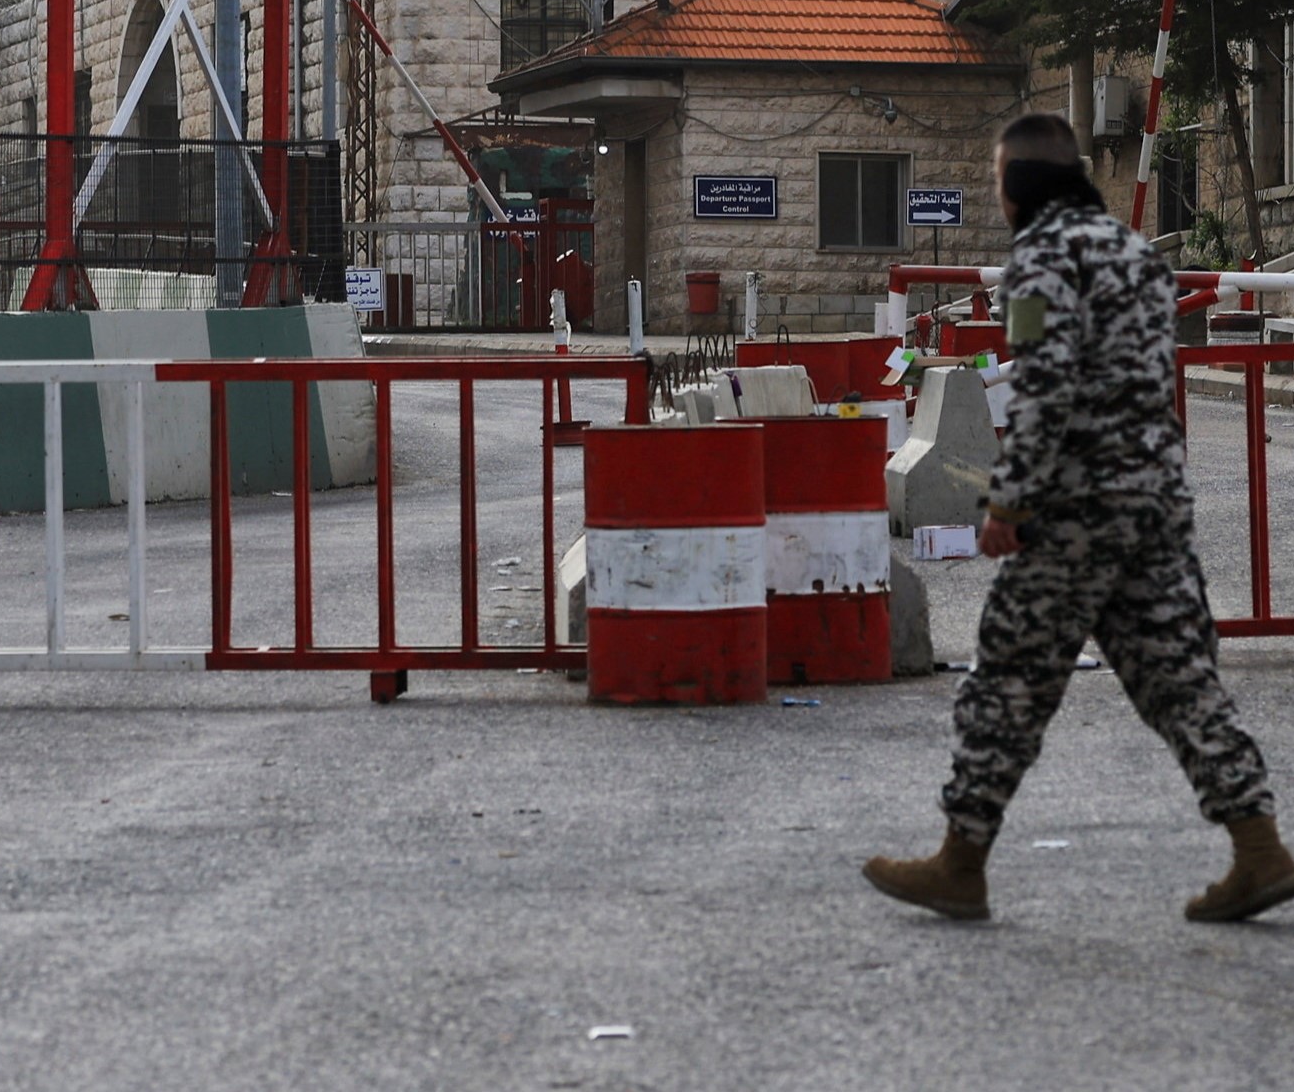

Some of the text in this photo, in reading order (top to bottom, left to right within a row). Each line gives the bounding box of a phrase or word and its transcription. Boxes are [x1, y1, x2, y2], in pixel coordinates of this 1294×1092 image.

[700, 195, 771, 203] Departure Passport
[909, 193, 960, 207] شعبة التحقيق
[722, 205, 749, 213] Control
